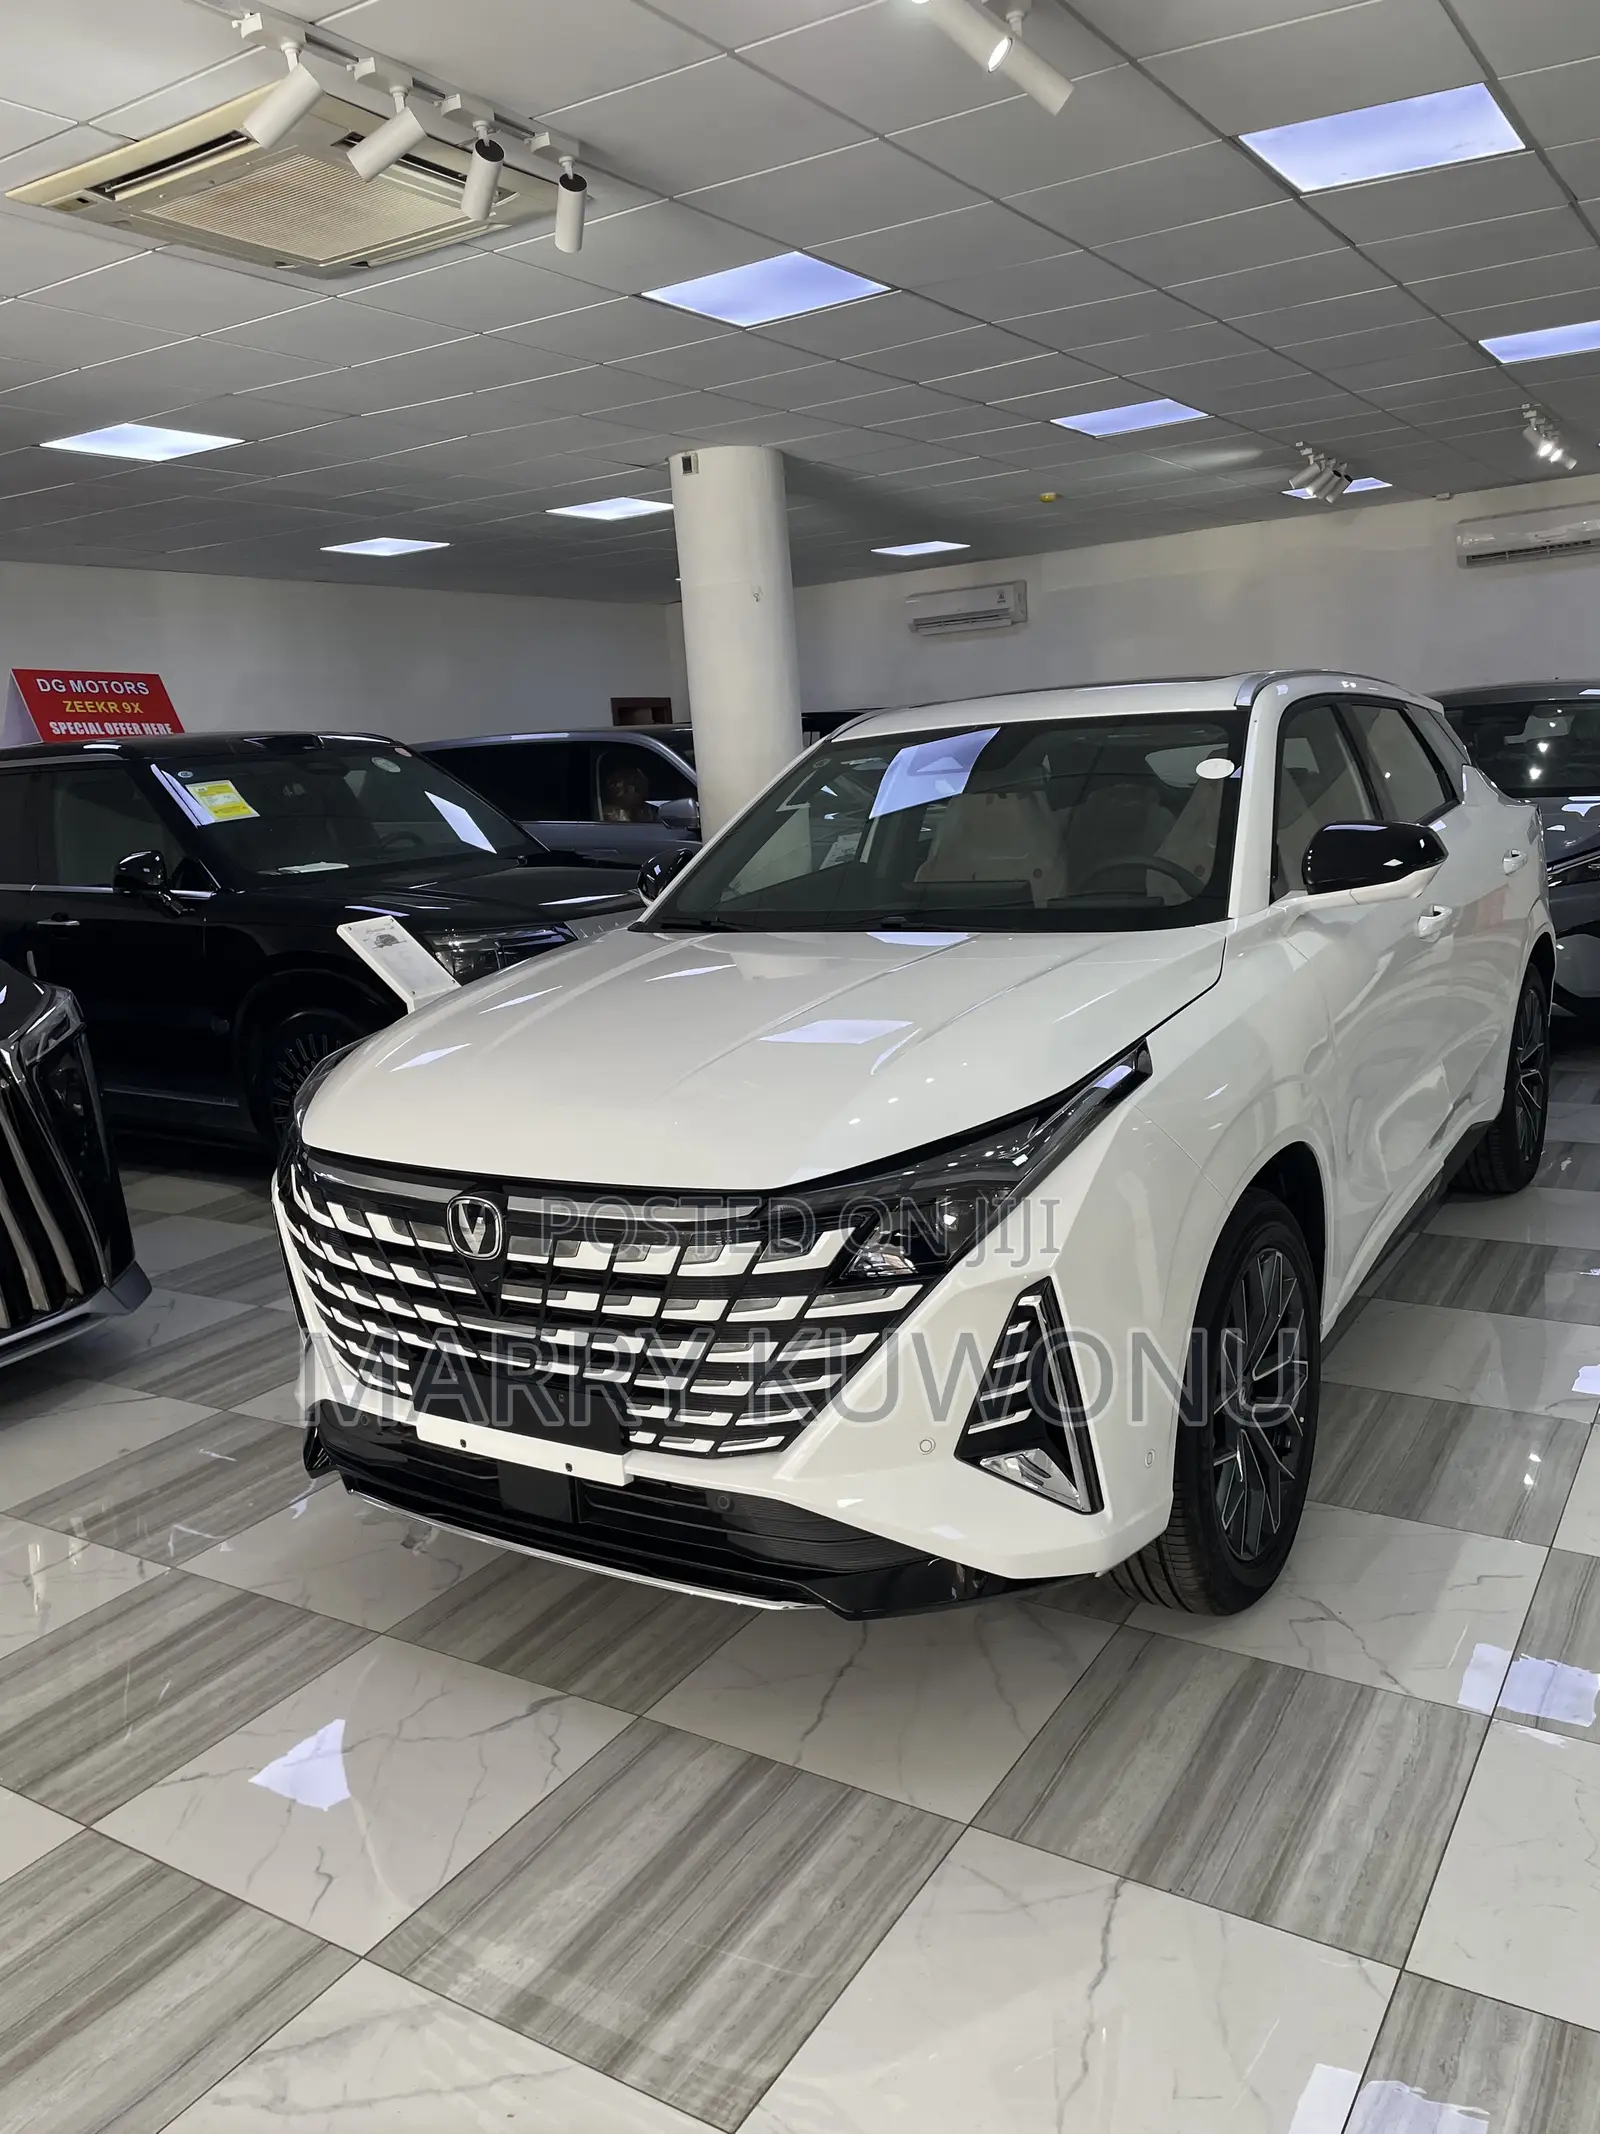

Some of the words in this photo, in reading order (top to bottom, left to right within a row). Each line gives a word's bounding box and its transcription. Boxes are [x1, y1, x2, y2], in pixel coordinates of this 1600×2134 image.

[36, 678, 66, 693] DG
[69, 679, 150, 695] MOTORS
[62, 700, 121, 714] ZEEKR
[122, 702, 144, 714] 9X
[49, 721, 105, 735] SPECIAL
[105, 722, 143, 735] OFFER
[141, 723, 174, 735] HERE
